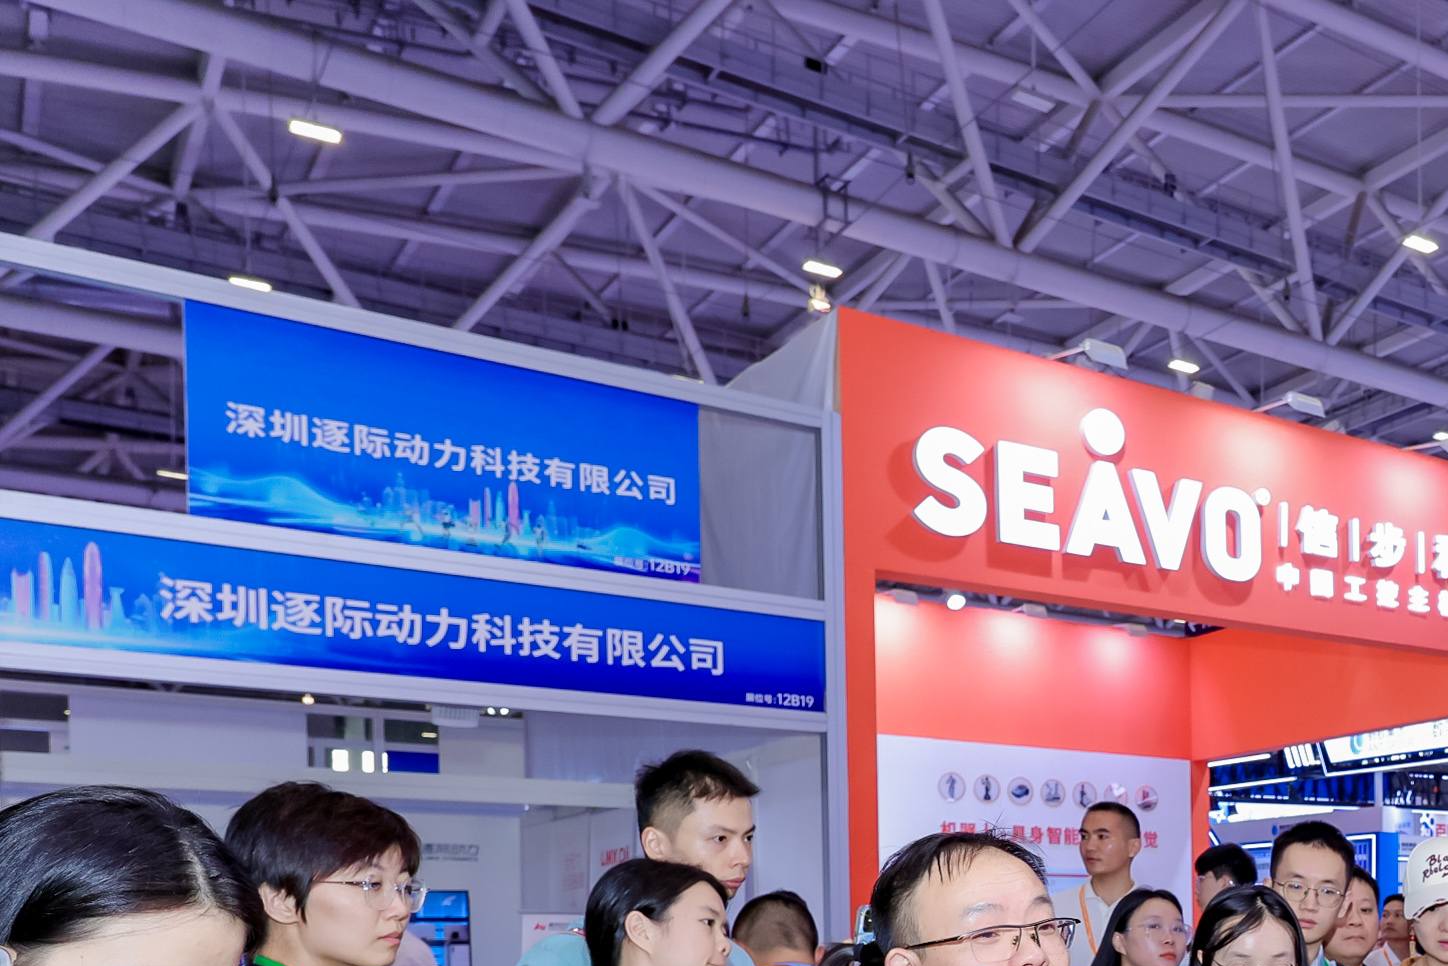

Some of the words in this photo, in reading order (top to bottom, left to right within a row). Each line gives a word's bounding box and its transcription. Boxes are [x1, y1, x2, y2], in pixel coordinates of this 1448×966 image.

[225, 401, 678, 507] 深圳逐际动力科技有限公司
[913, 408, 1263, 583] SEAVO
[159, 576, 726, 677] 深圳逐际动力科技有限公司
